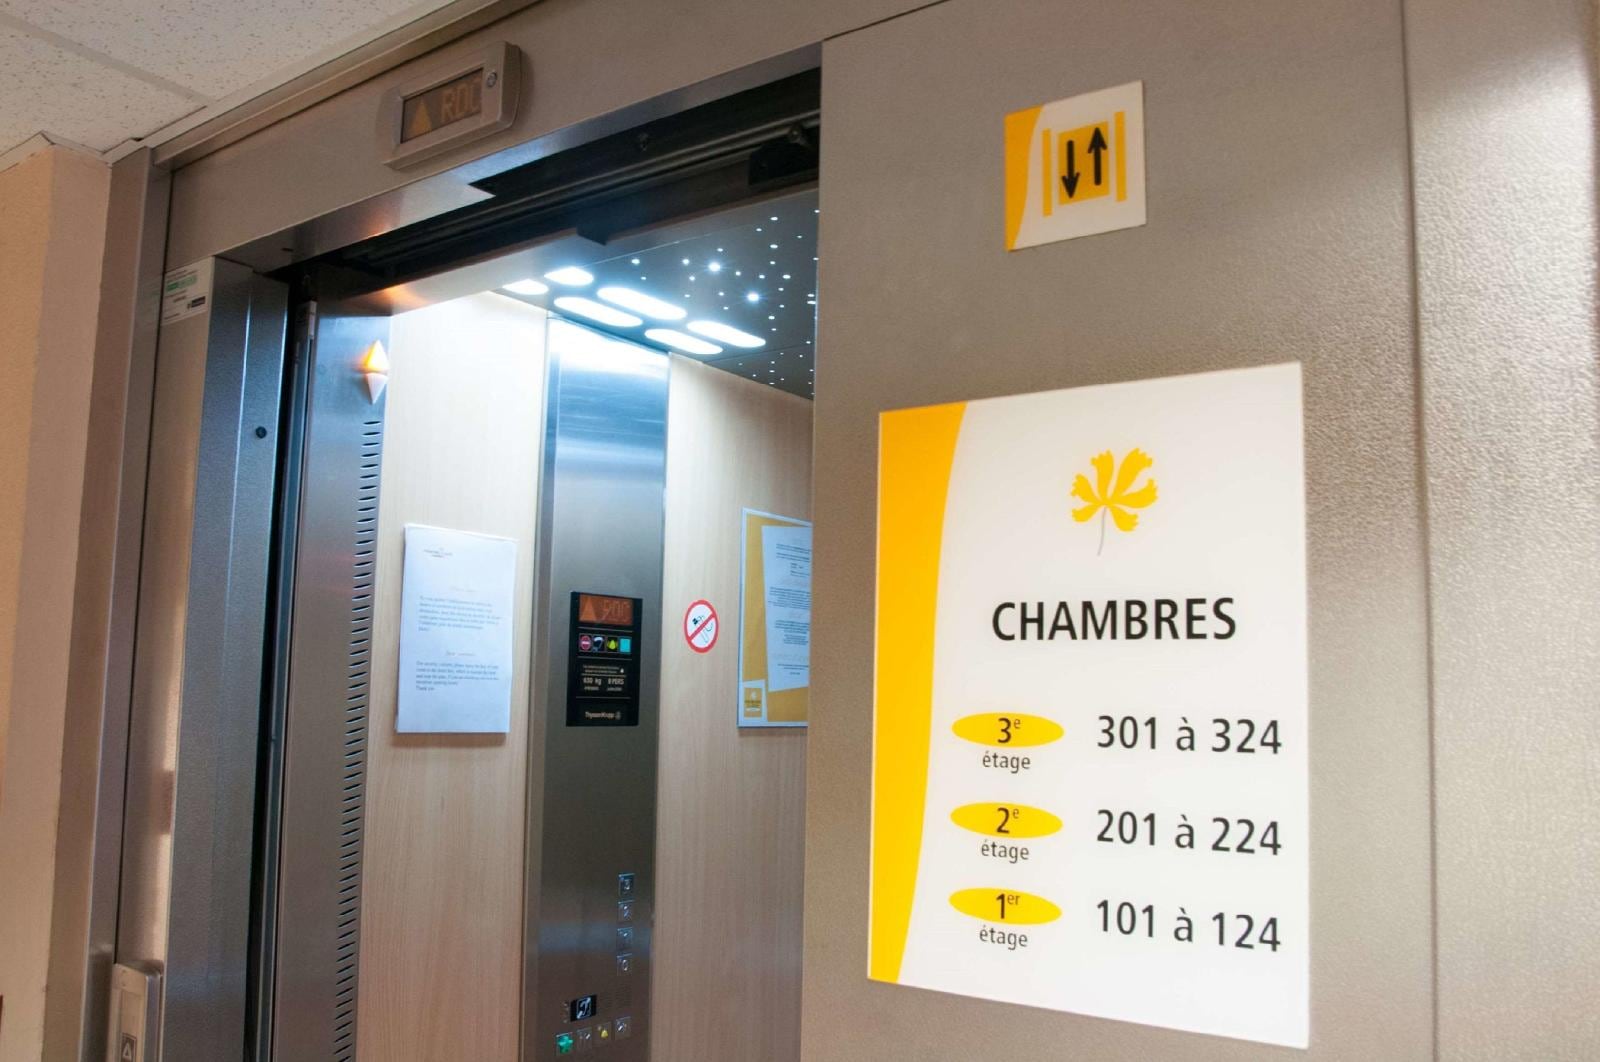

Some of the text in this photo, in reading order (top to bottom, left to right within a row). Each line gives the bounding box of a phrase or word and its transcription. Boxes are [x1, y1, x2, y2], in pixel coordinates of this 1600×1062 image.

[993, 597, 1236, 641] CHAMBRES
[1098, 715, 1282, 755] 301 à 324
[982, 751, 1031, 774] étage
[980, 839, 1030, 864] étage
[1097, 809, 1282, 856] 201 à 224
[979, 925, 1028, 950] étage
[1096, 899, 1281, 952] 101 à 124
